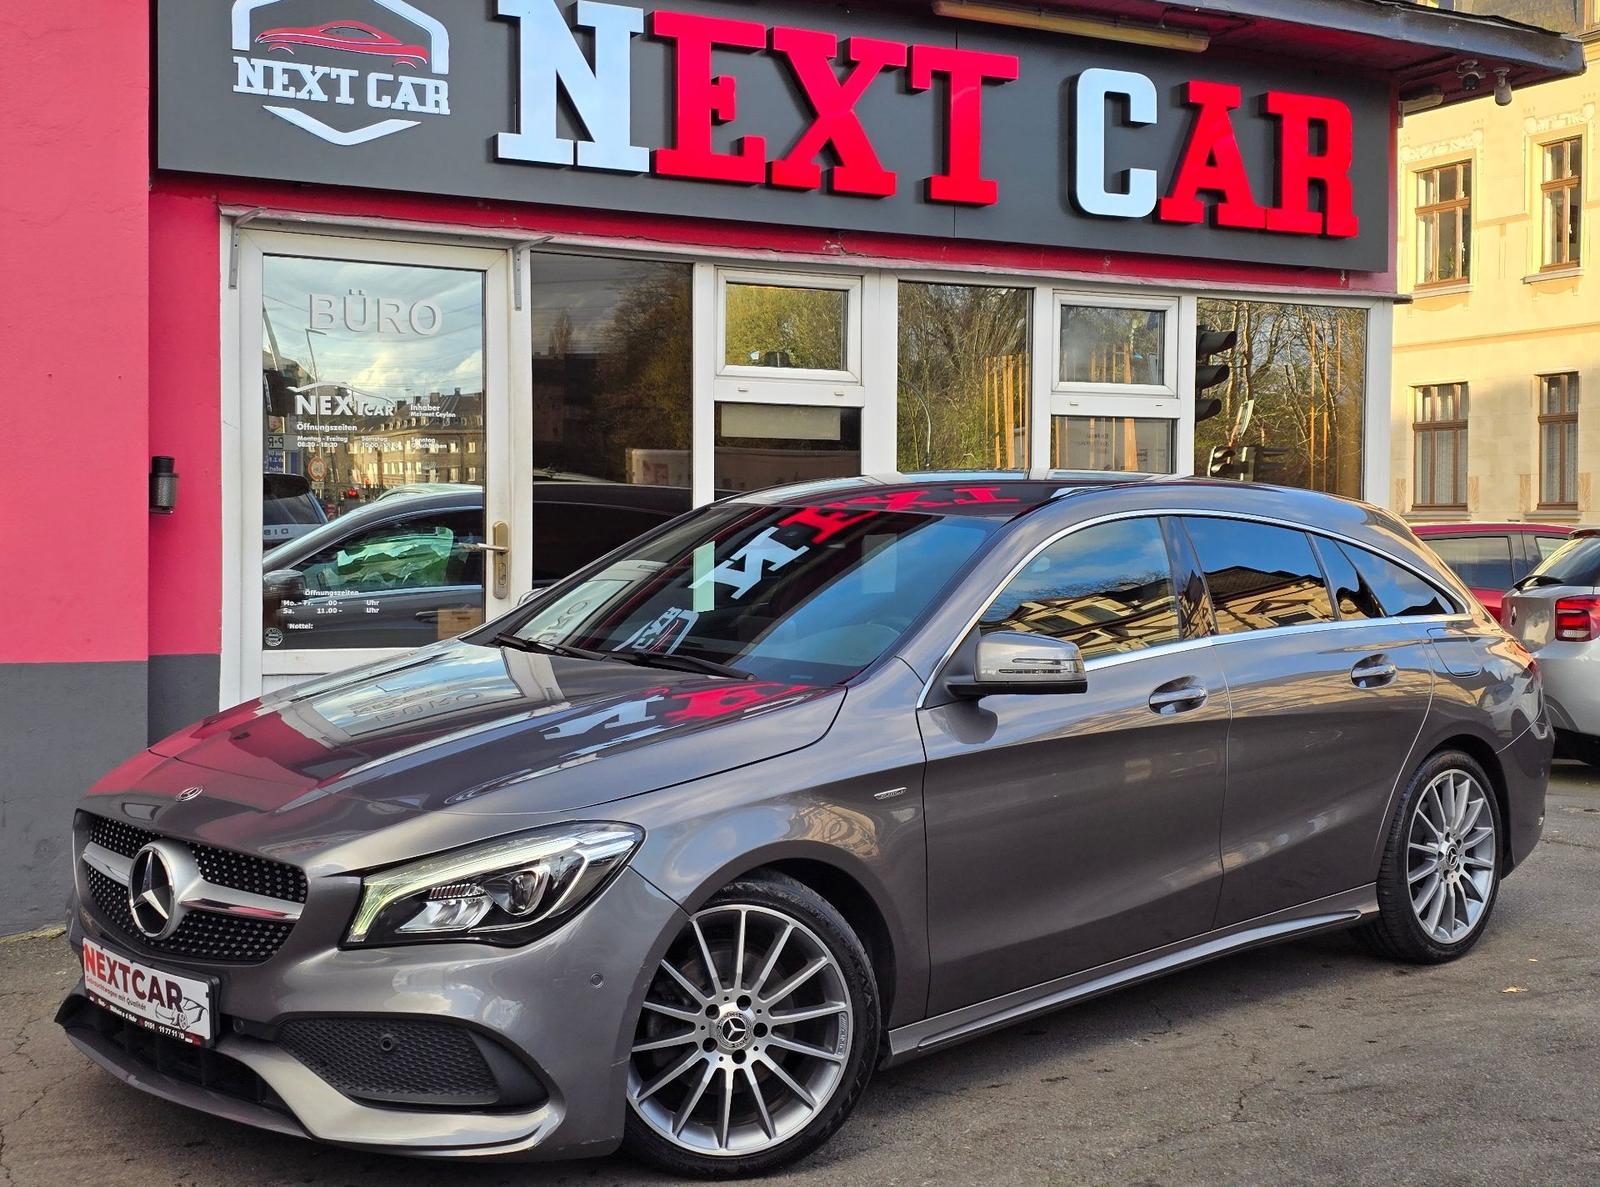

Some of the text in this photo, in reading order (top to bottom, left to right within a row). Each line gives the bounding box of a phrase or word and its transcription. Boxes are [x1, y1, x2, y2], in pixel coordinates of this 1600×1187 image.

[233, 56, 450, 115] NEXT CAR
[497, 0, 1359, 239] NEXT CAR
[309, 288, 443, 336] BÜRO
[410, 403, 441, 411] Inhaber
[296, 421, 358, 432] Öffnungszeiten
[297, 435, 322, 443] Montag
[326, 435, 349, 443] Freitag
[304, 588, 360, 597] Öffnungszeiten
[83, 943, 184, 1013] NEXTCAR
